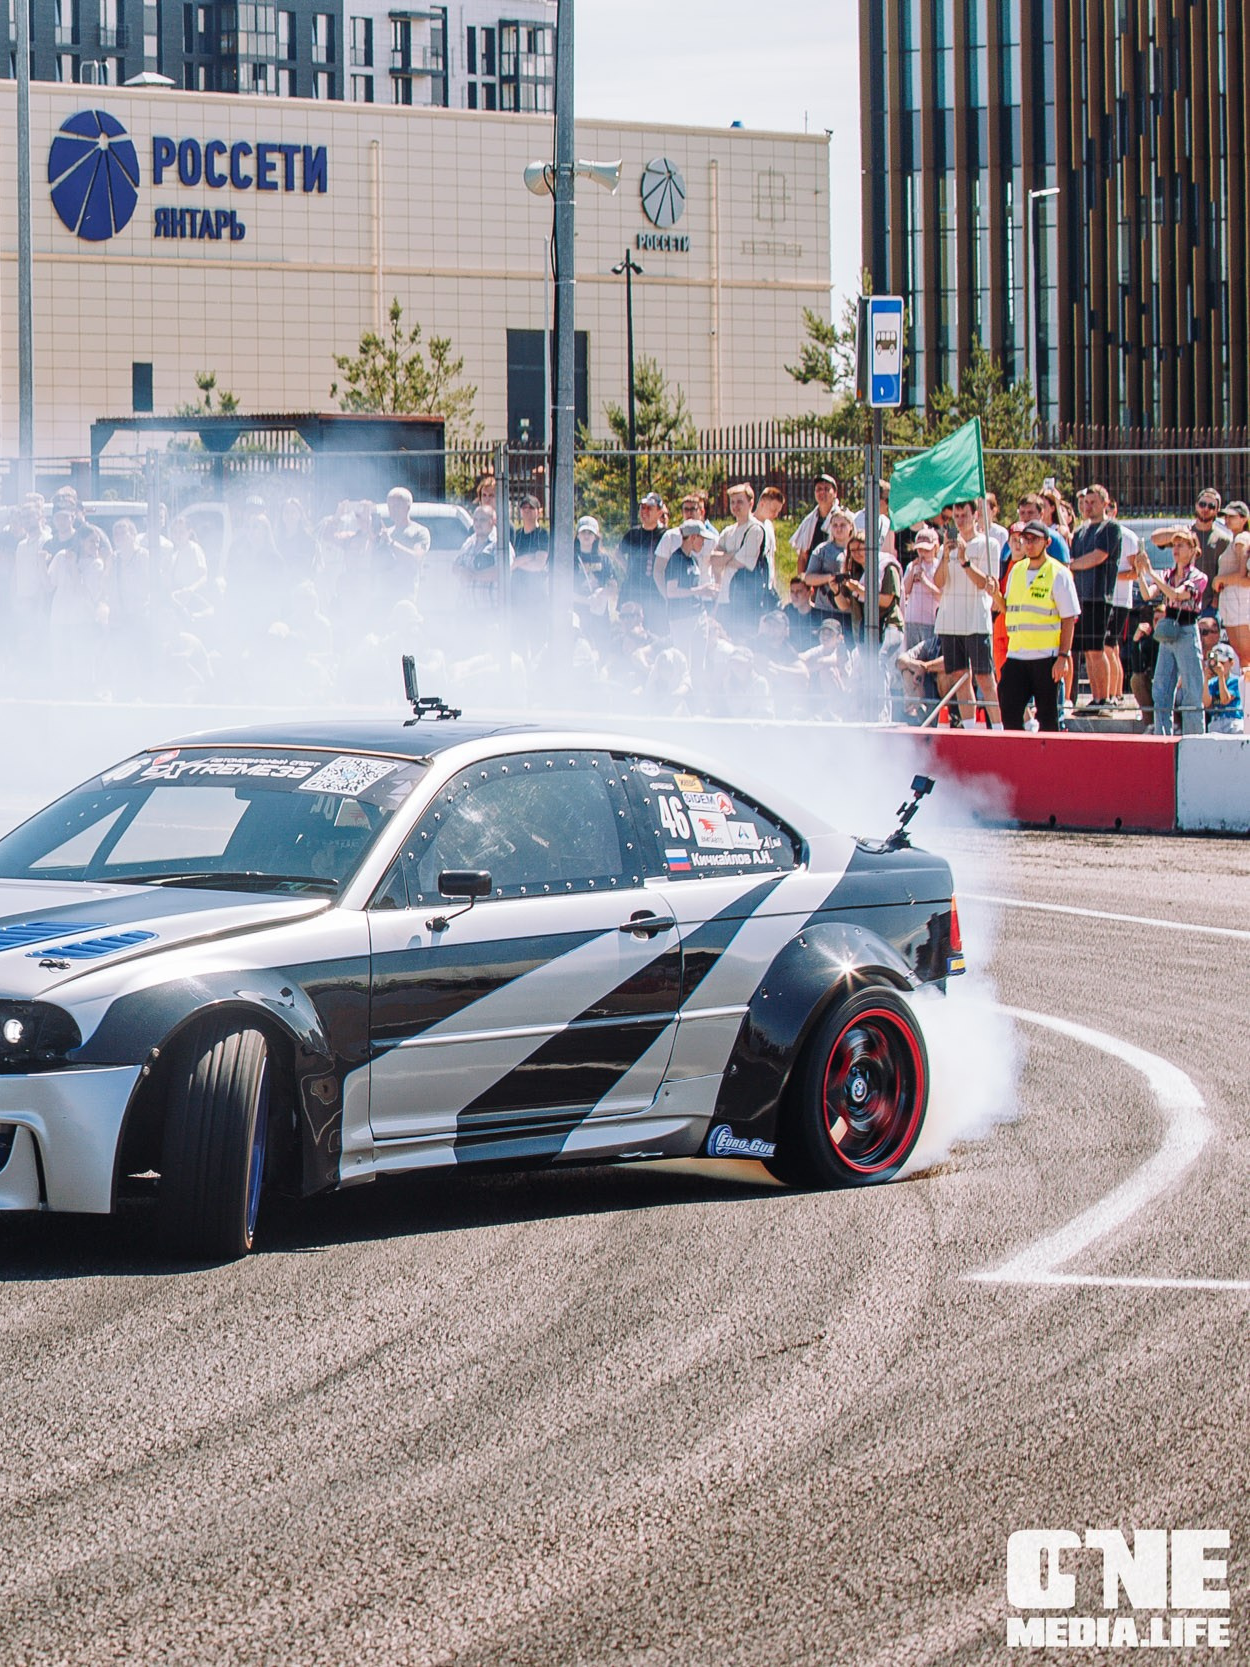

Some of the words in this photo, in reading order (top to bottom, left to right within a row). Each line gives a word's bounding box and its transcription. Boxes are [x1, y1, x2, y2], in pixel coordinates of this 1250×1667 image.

[152, 135, 328, 193] РОССЕТИ
[154, 207, 246, 241] ЯНТАРЬ
[637, 233, 690, 252] РОССЕТИ
[132, 756, 313, 785] EXTREME39
[658, 795, 690, 839] 46
[691, 851, 752, 866] Кичкайлов
[752, 850, 774, 864] А.Н.
